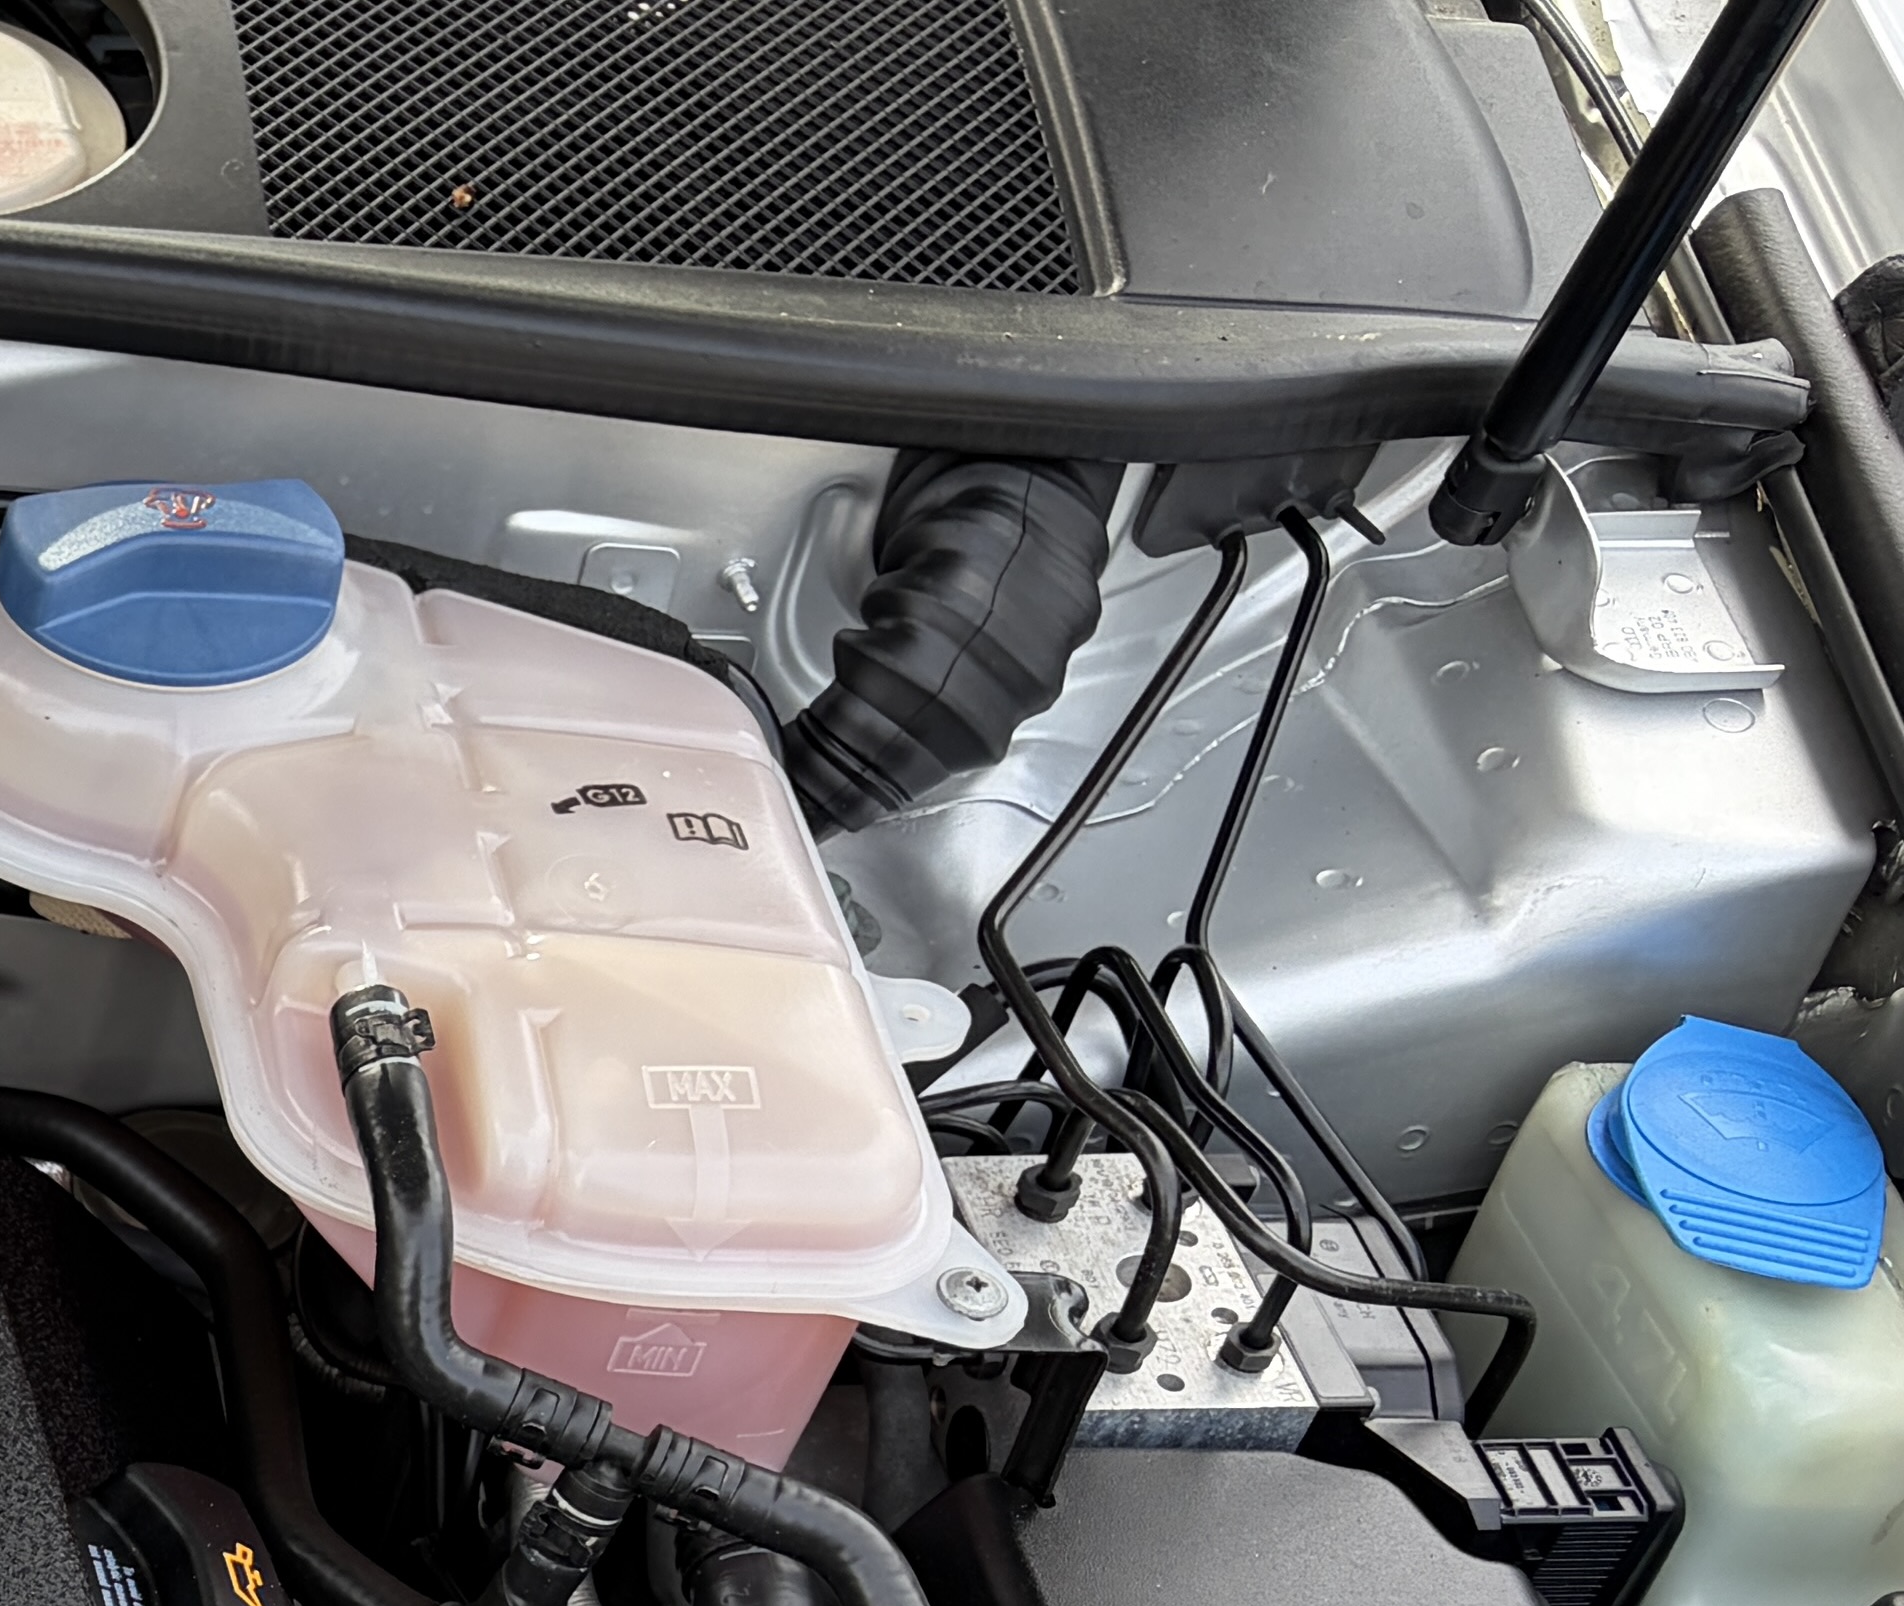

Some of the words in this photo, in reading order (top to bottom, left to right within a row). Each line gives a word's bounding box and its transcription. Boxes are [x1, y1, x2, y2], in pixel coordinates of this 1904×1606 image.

[585, 786, 641, 805] G12
[668, 1070, 735, 1105] MAX
[628, 1344, 692, 1374] MIN
[1275, 1382, 1306, 1403] VR
